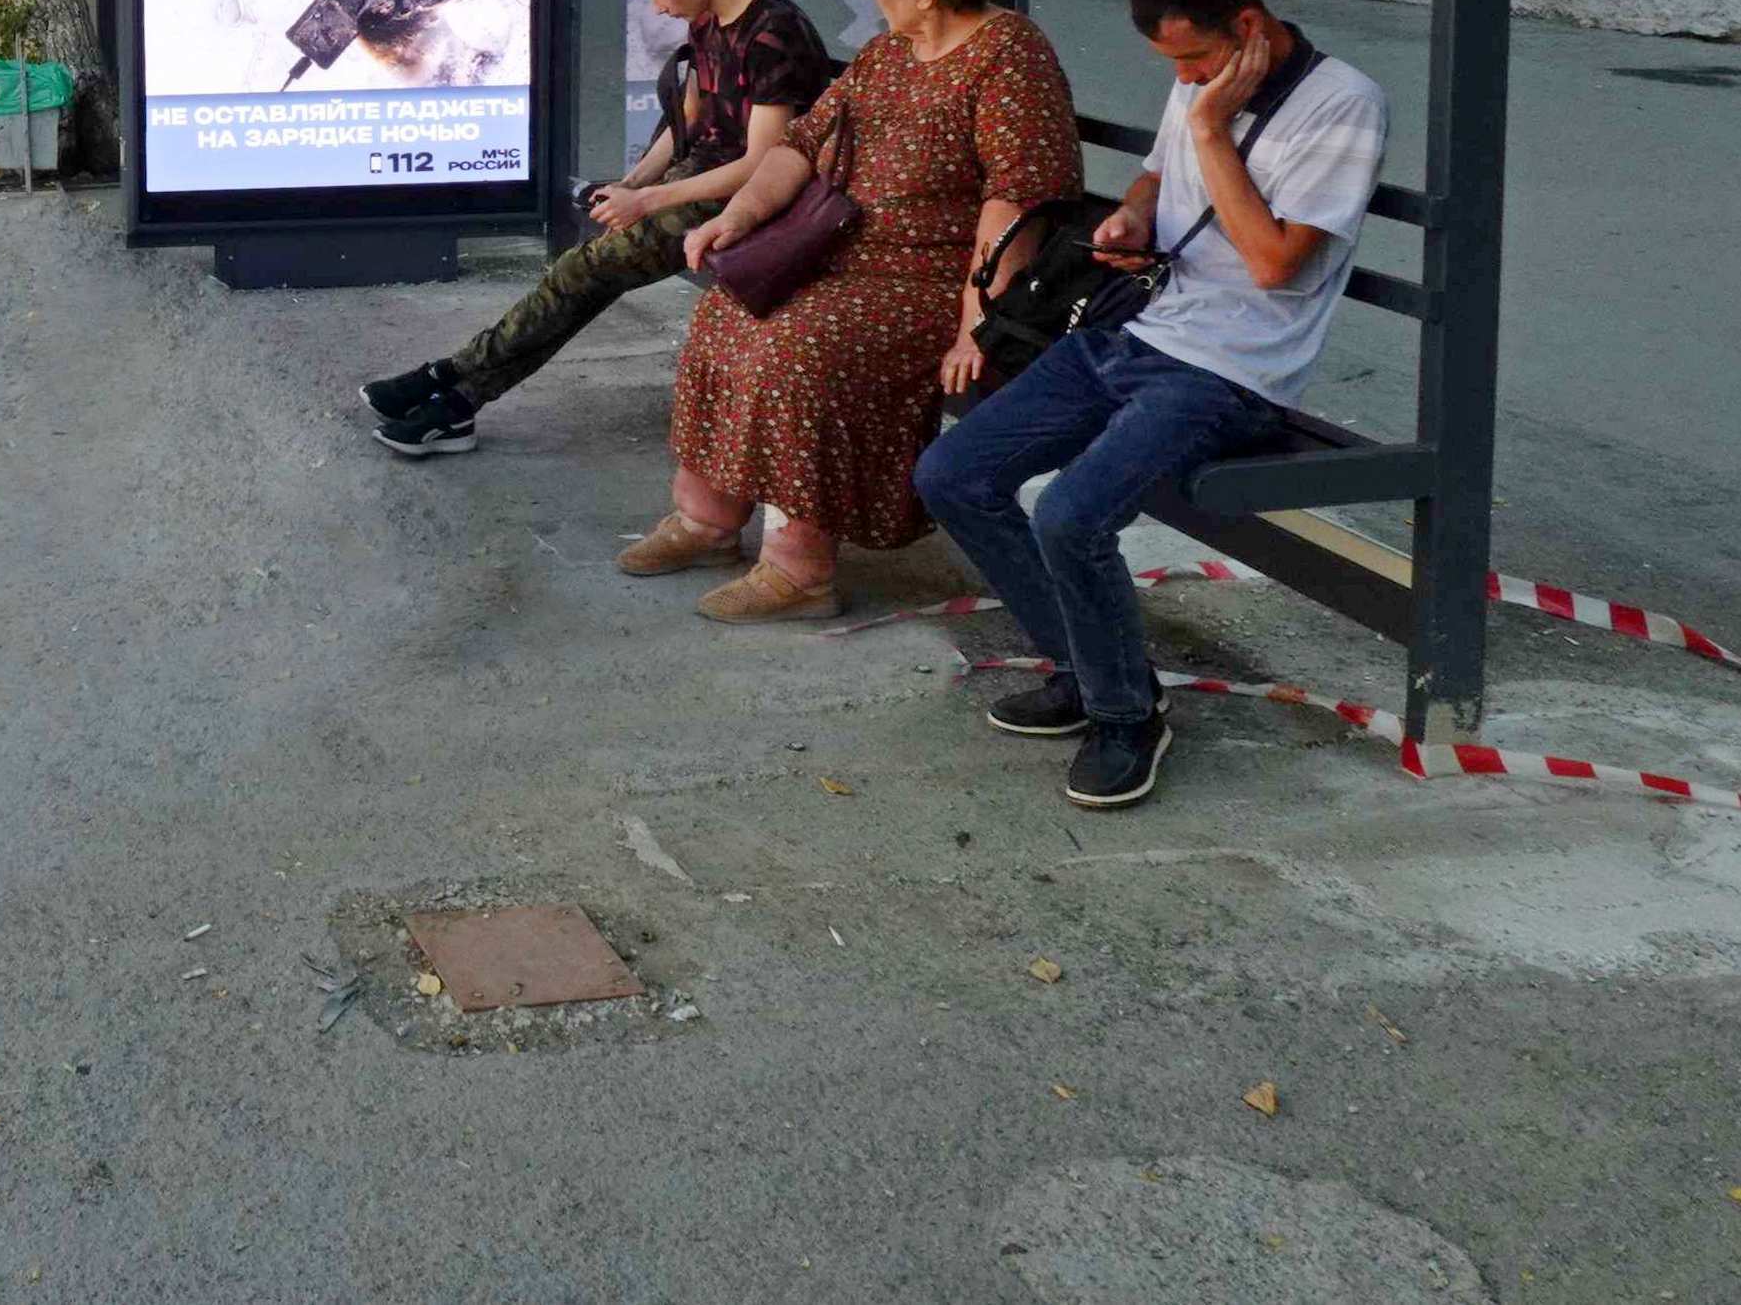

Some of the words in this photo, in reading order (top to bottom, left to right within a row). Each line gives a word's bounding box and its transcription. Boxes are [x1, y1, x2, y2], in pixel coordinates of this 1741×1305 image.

[151, 107, 188, 126] НЕ
[194, 99, 381, 125] ОСТАВЛЯЙТЕ
[386, 97, 525, 120] ГАДЖЕТЫ
[197, 131, 237, 149] НА
[244, 125, 373, 148] ЗАРЯДКЕ
[380, 122, 480, 143] НОЧЬЮ
[387, 152, 434, 172] 112
[482, 148, 521, 159] МЧС
[448, 160, 521, 171] РОССИИ
